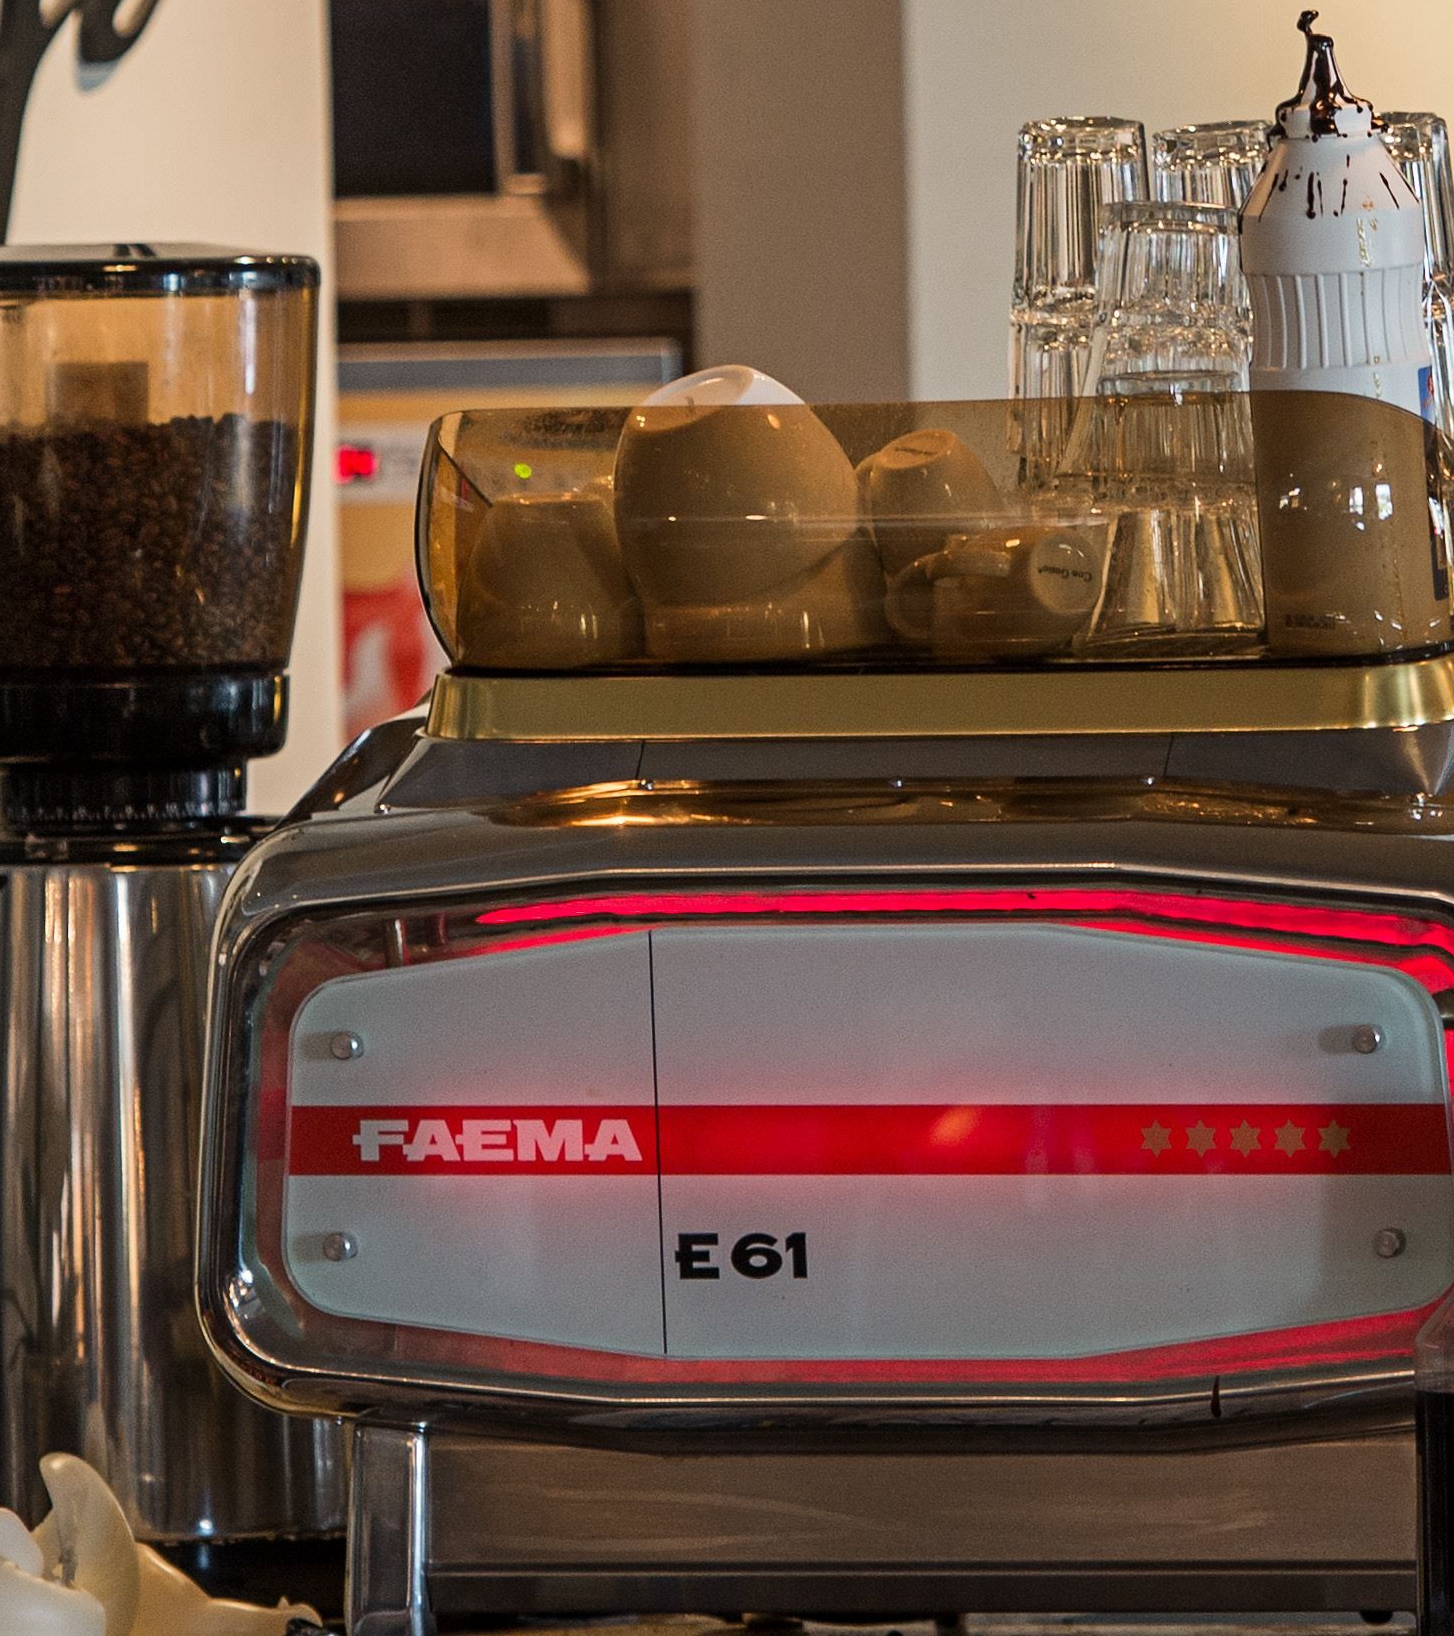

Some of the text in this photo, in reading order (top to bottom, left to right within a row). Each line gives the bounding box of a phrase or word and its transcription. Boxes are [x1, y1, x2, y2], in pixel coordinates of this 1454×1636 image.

[353, 1119, 643, 1162] FAEMA
[675, 1231, 808, 1279] E 61
